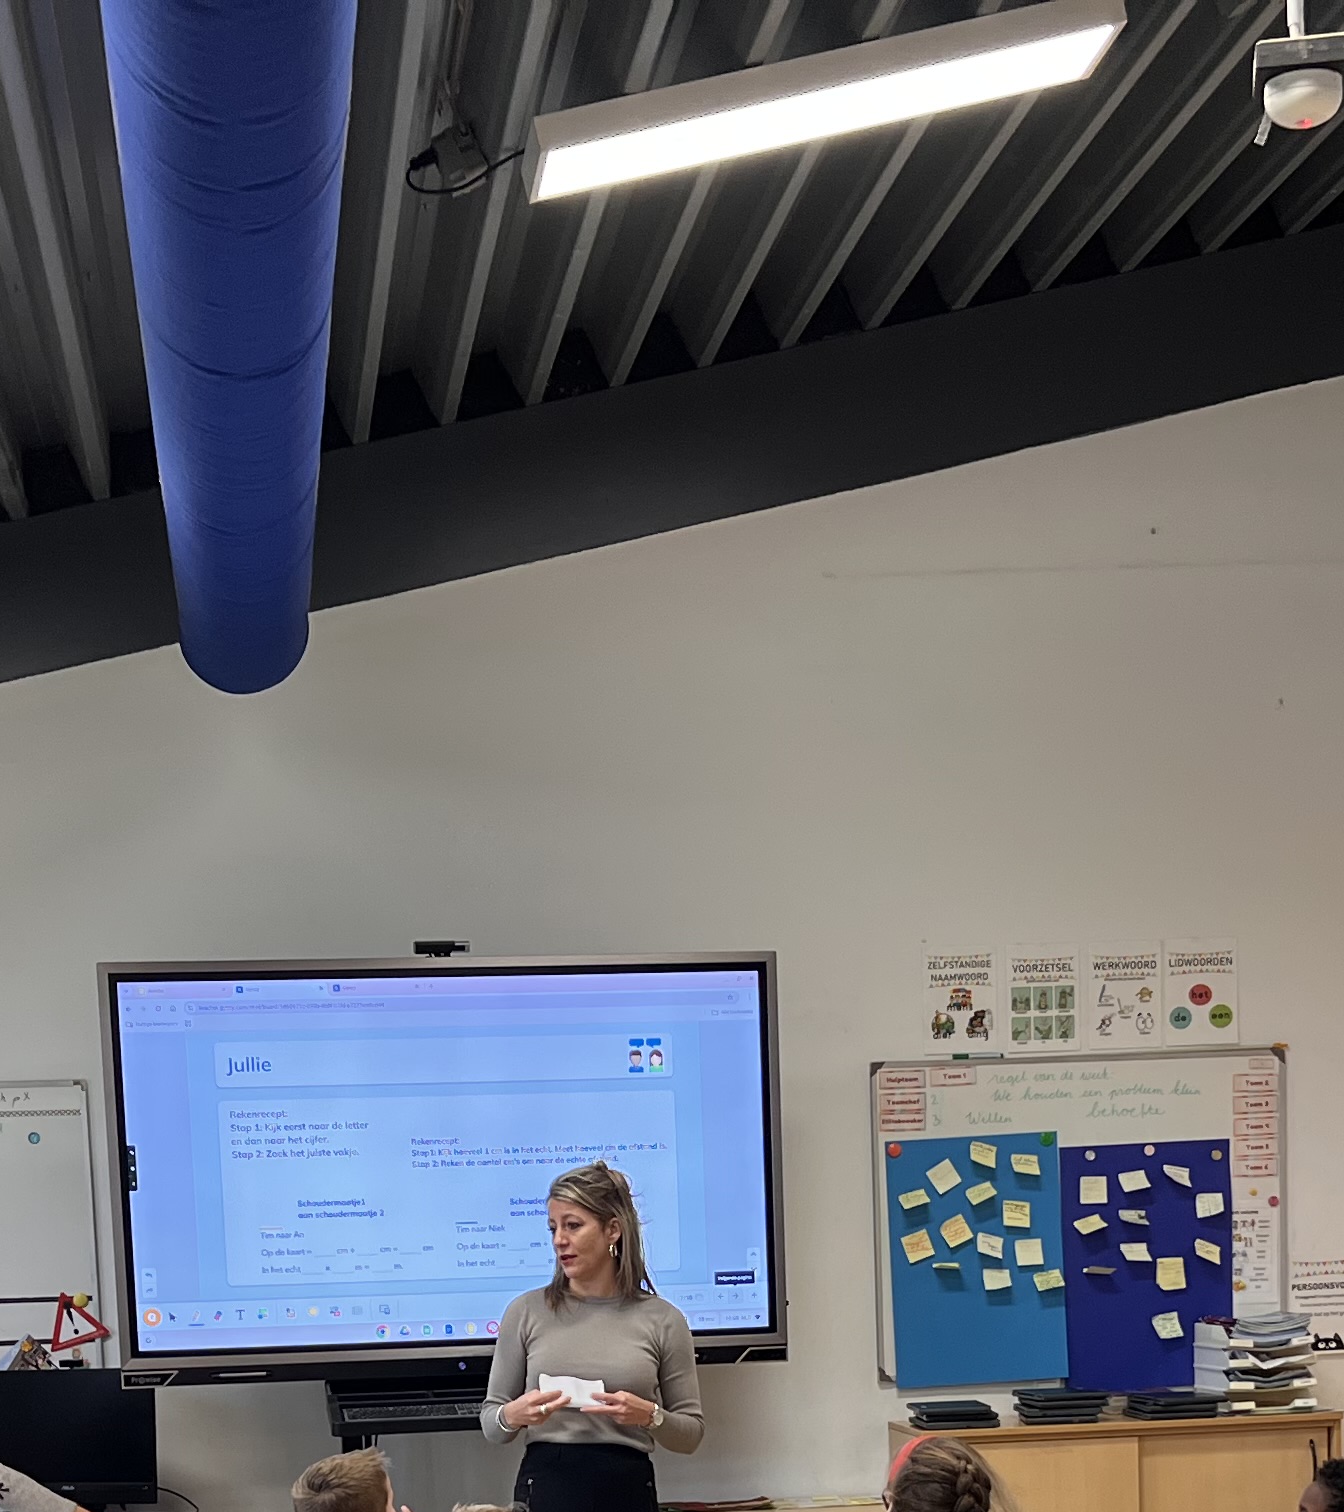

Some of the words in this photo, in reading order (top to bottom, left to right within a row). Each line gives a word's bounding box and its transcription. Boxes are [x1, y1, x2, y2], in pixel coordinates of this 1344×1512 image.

[927, 959, 992, 970] ZELFSTANDIGE
[1092, 960, 1157, 971] WERKWOORD
[1168, 957, 1233, 968] LIDWOORDEN
[1012, 963, 1075, 974] VOORZETSEL
[930, 972, 989, 982] NAAMWOORD
[1191, 989, 1209, 1000] het
[1174, 1013, 1187, 1022] de
[1211, 1012, 1230, 1020] een
[227, 1056, 272, 1077] Jullie
[1033, 1071, 1056, 1083] van
[1059, 1068, 1075, 1081] de
[1022, 1086, 1073, 1100] houden
[1108, 1083, 1165, 1102] probleem
[1170, 1080, 1202, 1097] klein
[229, 1110, 288, 1122] Rekenrecept:
[230, 1123, 252, 1134] Stap
[264, 1122, 282, 1134] Kijk
[283, 1122, 306, 1132] eerst
[308, 1122, 329, 1131] naar
[331, 1121, 343, 1131] de
[344, 1120, 369, 1131] letter
[230, 1137, 242, 1146] en
[244, 1136, 261, 1146] dan
[262, 1136, 286, 1146] naar
[287, 1135, 303, 1145] het
[304, 1134, 329, 1147] cijfer.
[231, 1150, 254, 1161] Stap
[266, 1149, 288, 1159] Zoek
[289, 1148, 305, 1158] het
[306, 1148, 332, 1160] juiste
[333, 1147, 360, 1159] vakje.
[297, 1198, 361, 1208] Schoudermaatje
[297, 1211, 314, 1219] aan
[315, 1210, 378, 1219] schoudermaatje
